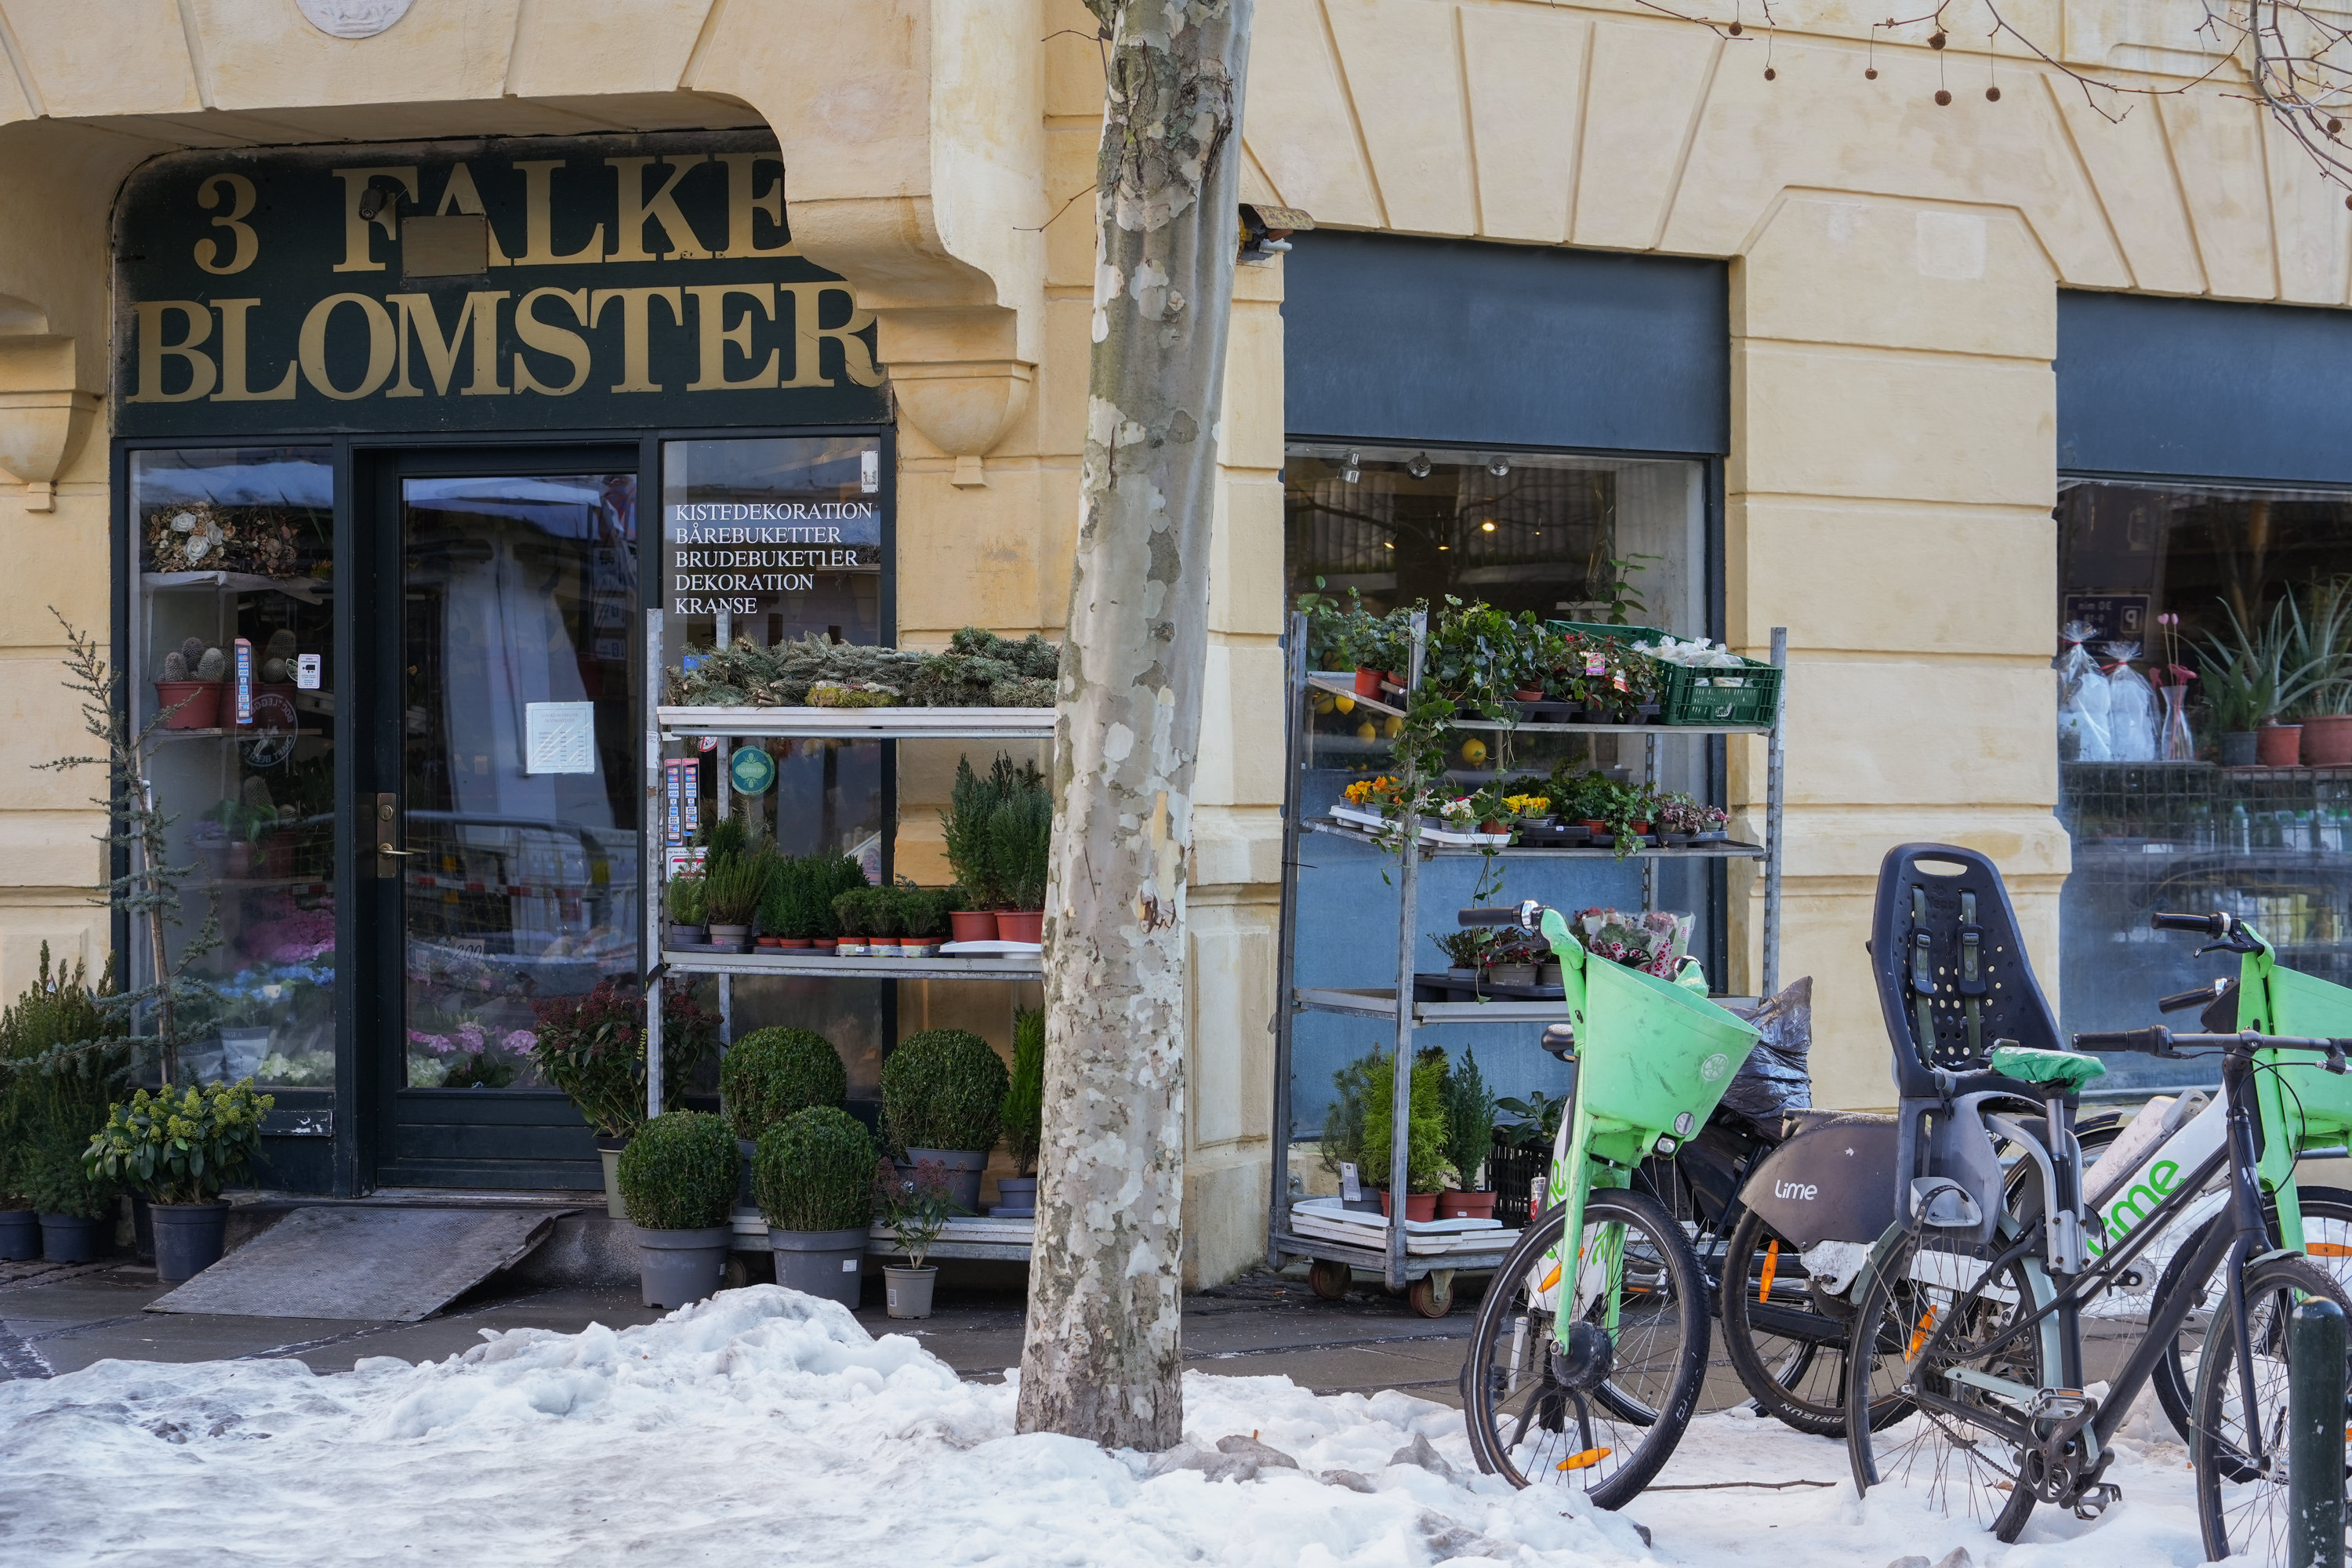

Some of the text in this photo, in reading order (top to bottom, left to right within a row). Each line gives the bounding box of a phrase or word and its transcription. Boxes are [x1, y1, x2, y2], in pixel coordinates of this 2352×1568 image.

[193, 152, 806, 275] 3 FALKE
[125, 280, 887, 404] BLOMSTER
[674, 523, 842, 544] BÅREBUKETTER
[674, 574, 815, 591] DEKORATION
[674, 597, 758, 615] KRANSE
[1780, 1402, 1846, 1424] ARISUN
